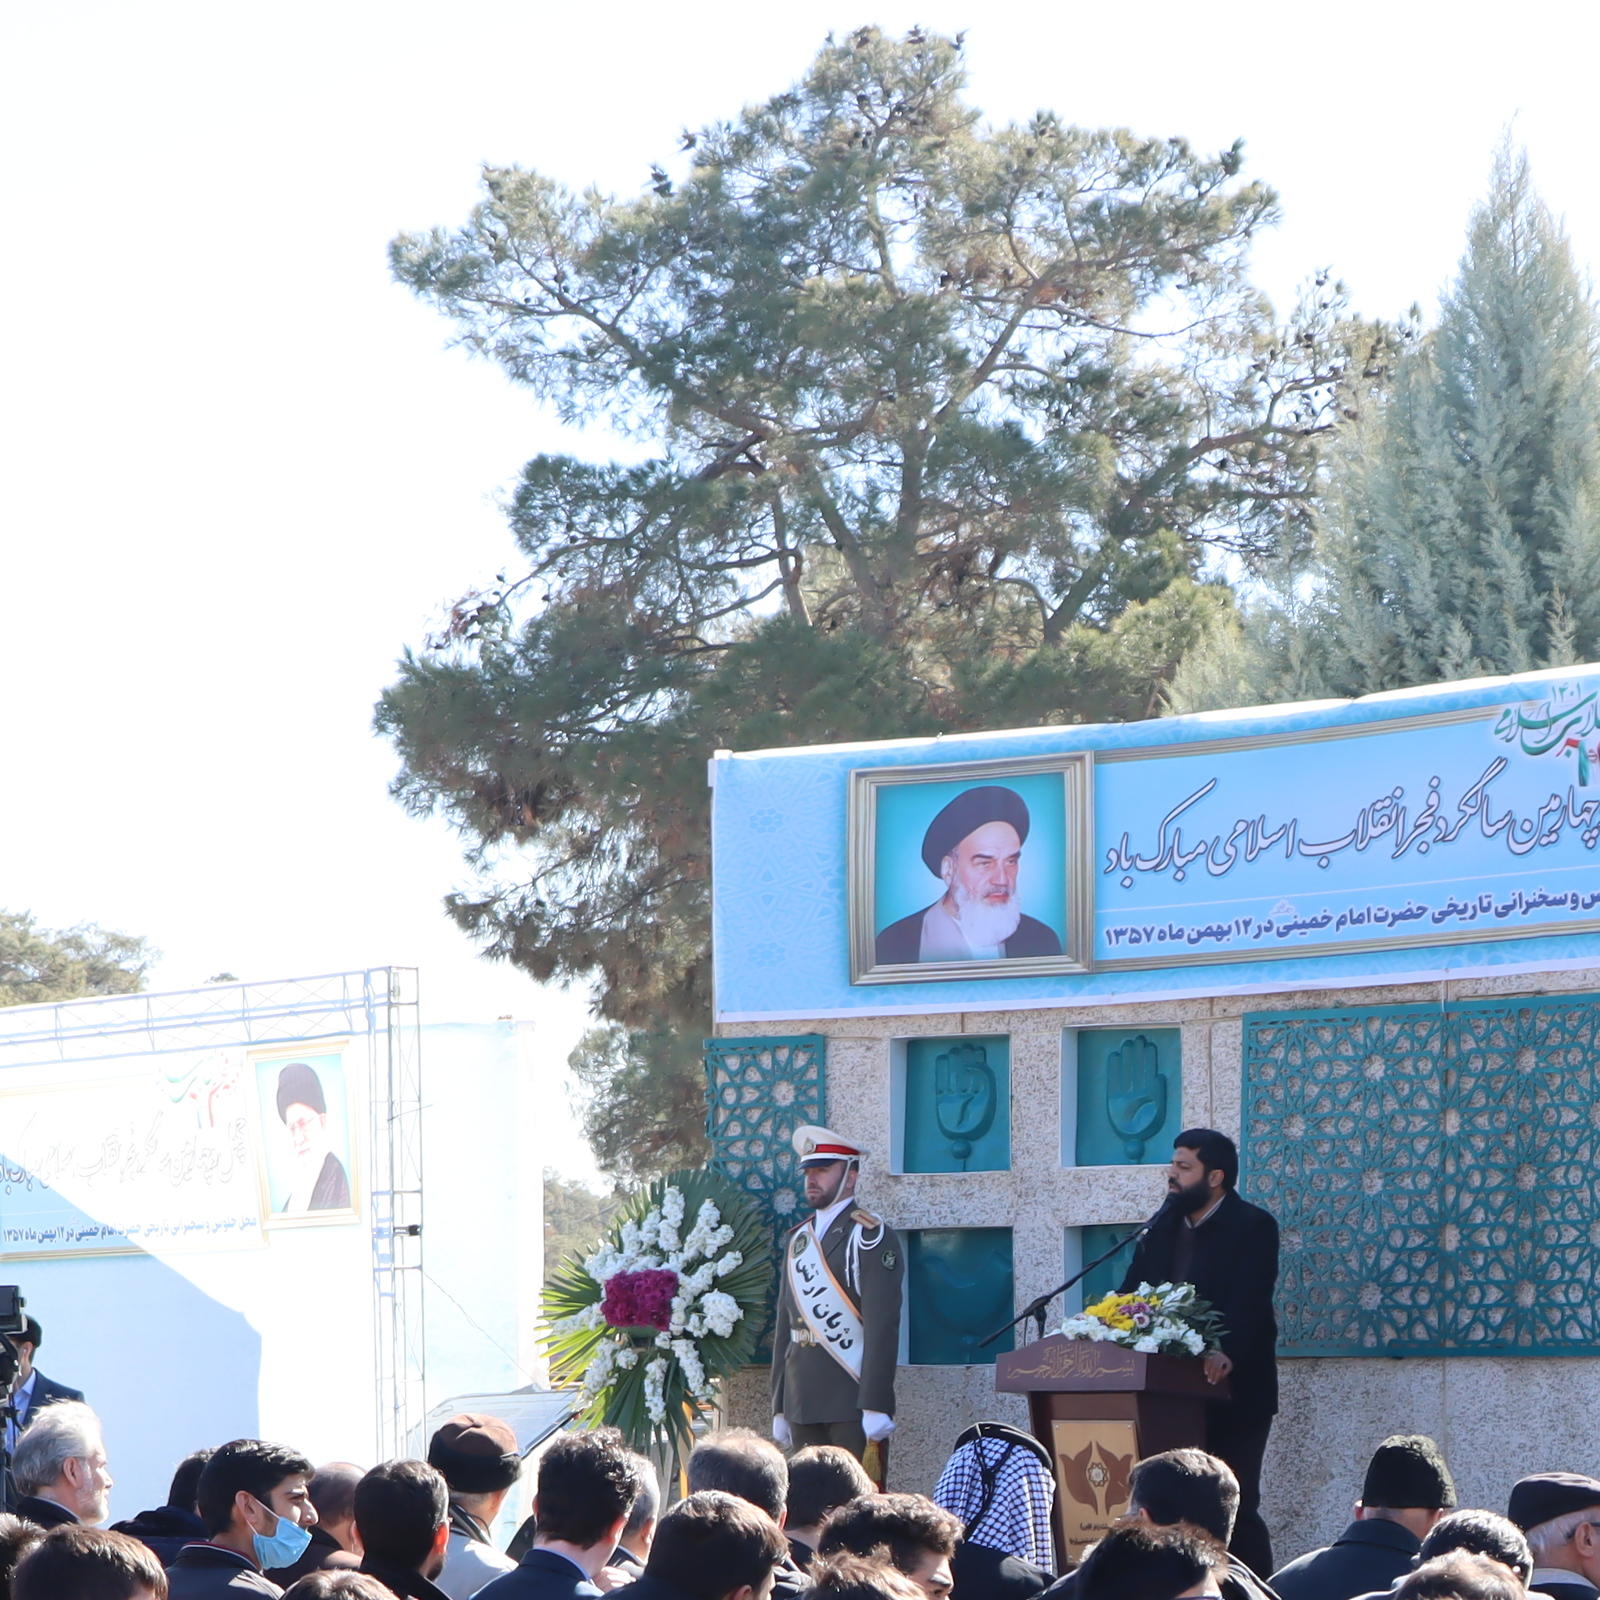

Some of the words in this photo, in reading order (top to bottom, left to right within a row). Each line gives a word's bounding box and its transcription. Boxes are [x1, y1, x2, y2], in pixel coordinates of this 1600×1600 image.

[1494, 690, 1598, 744] اسلامی
[1433, 755, 1513, 845] سالگرد
[1134, 776, 1218, 882] مبارک
[1298, 786, 1407, 869] انقلاب
[1391, 775, 1441, 860] فجر
[1103, 831, 1135, 889] باد
[1207, 814, 1299, 877] اسلامی
[1372, 899, 1429, 928] حضرت
[1430, 892, 1493, 925] تاریخی
[1494, 886, 1568, 919] سخنرانی
[1104, 925, 1155, 947] ۱۳۵۷
[1157, 922, 1185, 942] ماه
[1186, 921, 1233, 946] بهمن
[1233, 916, 1253, 937] ۱۲
[1252, 916, 1274, 940] در
[1275, 907, 1334, 938] خمینی
[1335, 905, 1372, 934] امام
[795, 1257, 827, 1299] ارتش
[811, 1302, 853, 1351] دژبان
